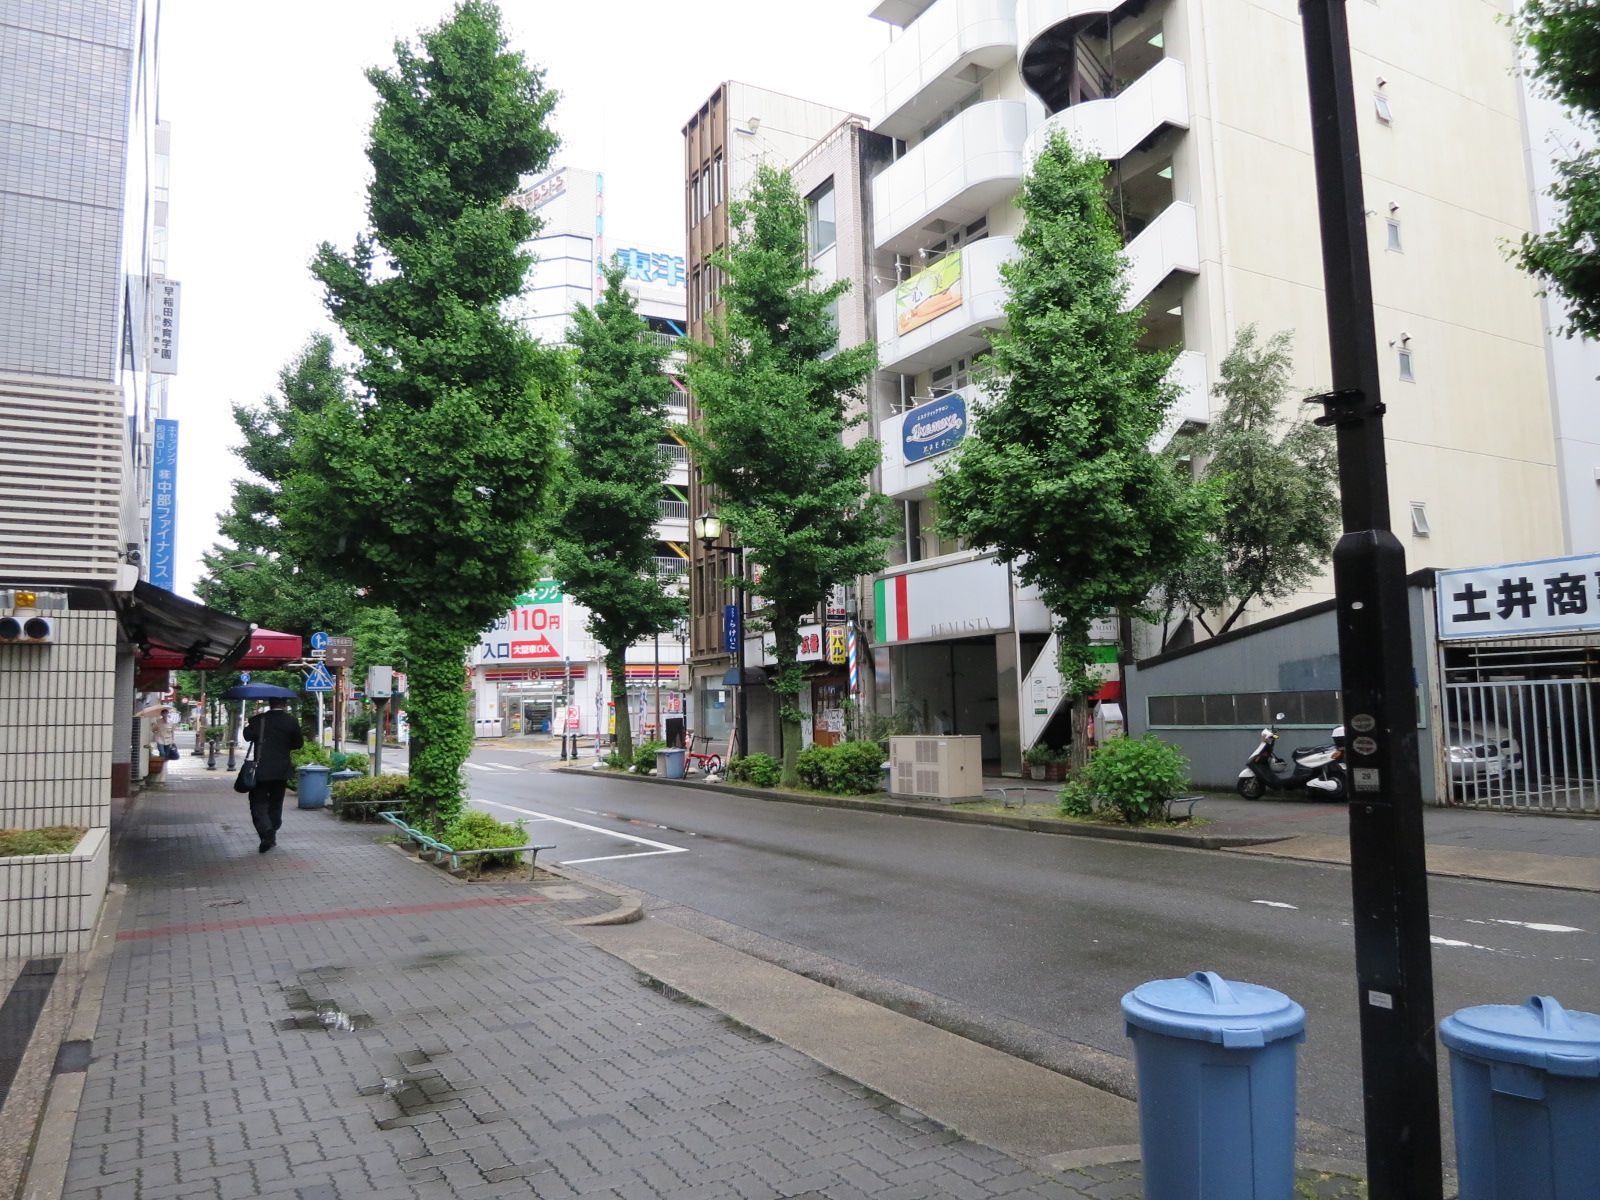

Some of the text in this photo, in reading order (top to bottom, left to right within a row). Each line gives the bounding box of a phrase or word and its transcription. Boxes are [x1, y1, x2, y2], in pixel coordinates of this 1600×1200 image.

[161, 286, 174, 359] 早稲田教育学園
[1452, 572, 1600, 622] 土井商
[483, 642, 551, 659] 入口 大型車OK
